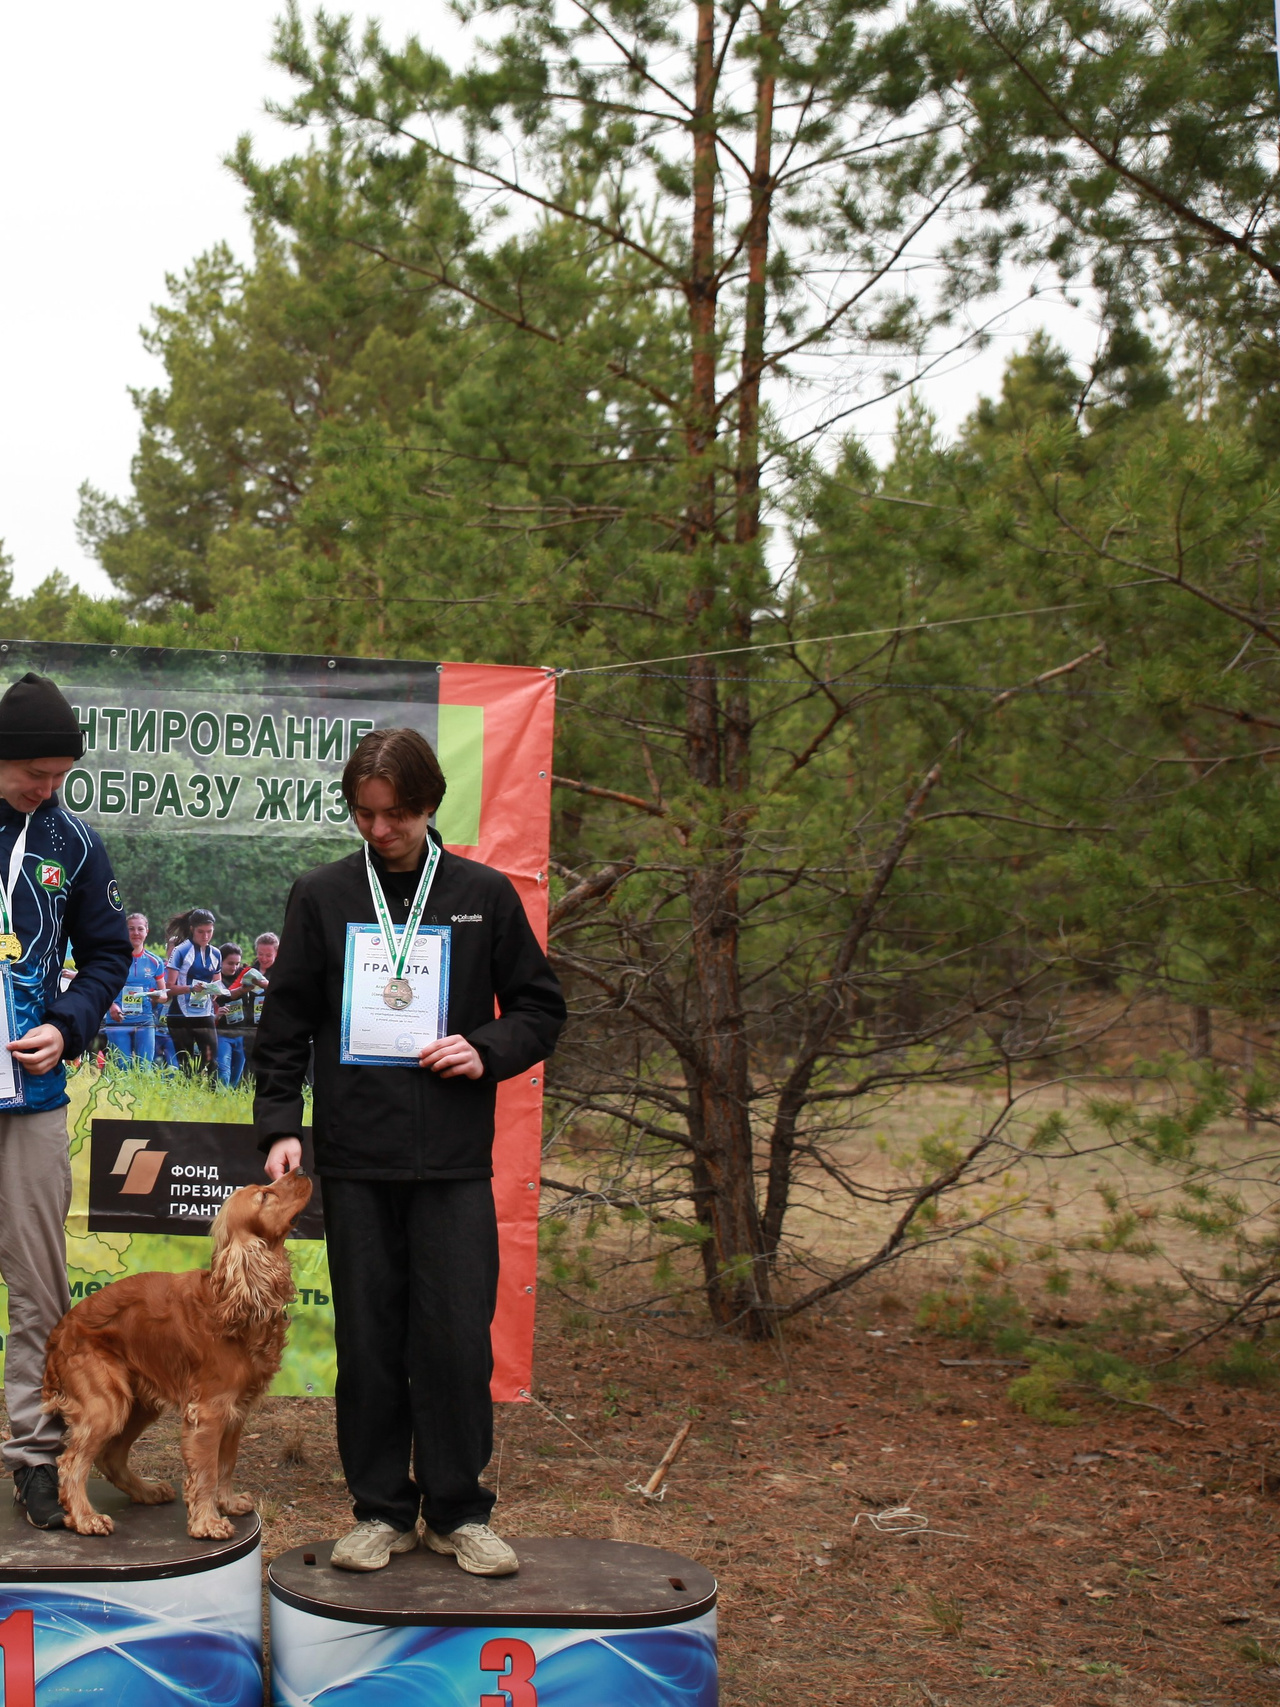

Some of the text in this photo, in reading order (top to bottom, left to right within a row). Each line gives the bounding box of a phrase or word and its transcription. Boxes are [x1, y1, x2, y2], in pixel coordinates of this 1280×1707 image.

[63, 768, 242, 820] ОБРАЗУ
[255, 777, 350, 824] ЖИЗ
[171, 1165, 219, 1180] ФОНД
[169, 1203, 221, 1216] ГРАНТ
[480, 1637, 538, 1707] 3
